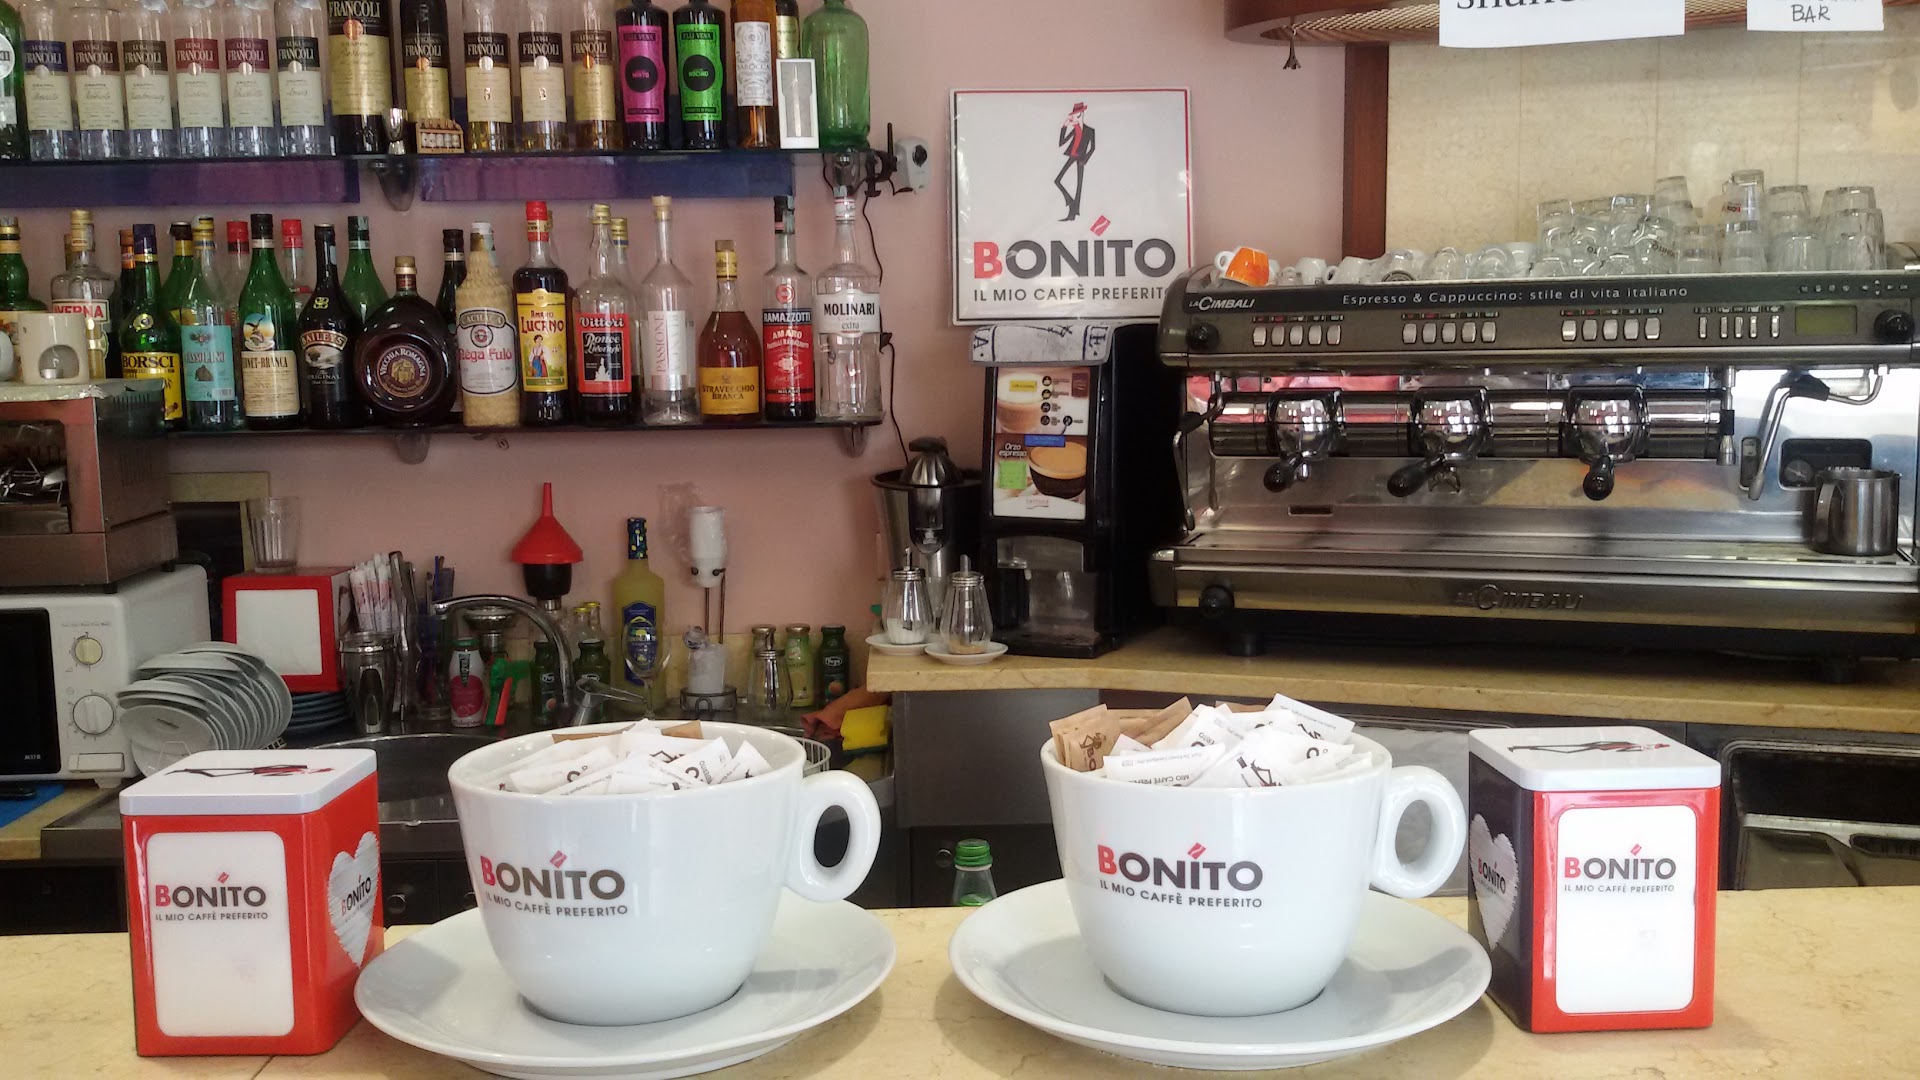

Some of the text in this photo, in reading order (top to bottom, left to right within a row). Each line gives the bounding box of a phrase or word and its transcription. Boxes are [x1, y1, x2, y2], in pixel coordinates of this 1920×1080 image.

[328, 0, 381, 18] FRANCOLI
[1791, 3, 1831, 22] BAR
[278, 48, 314, 60] FRANCOLI
[405, 44, 442, 57] FRANCOLI
[467, 43, 505, 56] FRANCOLI
[522, 43, 559, 55] FRANCOLI
[573, 42, 607, 54] FRANCOLI
[24, 51, 62, 64] FRANCOLI
[75, 51, 114, 64] FRANCOLI
[125, 51, 162, 64] FRANCOLI
[177, 49, 214, 62] FRANCOLI
[228, 50, 264, 62] FRANCOLI
[973, 232, 1176, 279] BONITO
[973, 290, 987, 302] IL
[993, 288, 1027, 301] MIO
[1033, 284, 1085, 301] CAFFÈ
[1342, 286, 1688, 306] Espresso & Cappuccino: stile di vita italiano
[823, 302, 875, 316] MOLINARI
[1188, 295, 1255, 311] LA CIMBALI
[531, 310, 554, 319] AMARO
[763, 311, 811, 322] RAMAZZOTTI
[521, 317, 565, 333] LUCANO
[579, 317, 624, 328] Vittori
[841, 322, 860, 330] extra
[301, 331, 343, 346] BAILEYS
[772, 329, 803, 340] AMARO
[653, 314, 666, 373] PASSIONE
[122, 355, 175, 368] BORSCI
[379, 347, 427, 377] VECCHIA ROMAGNA
[712, 392, 745, 400] BRANCA
[998, 448, 1027, 458] espresso
[1004, 443, 1022, 451] Orzo
[1097, 844, 1264, 892] BONITO
[1564, 857, 1677, 880] BONITO
[480, 855, 626, 900] BONITO
[1478, 858, 1506, 895] BONITO
[1100, 880, 1263, 909] IL MIO CAFFÈ PREFERITO
[1575, 884, 1594, 892] MIO
[1597, 883, 1627, 893] CAFFÈ
[1630, 884, 1675, 893] PREFERITO
[155, 885, 267, 907] BONITO
[341, 876, 372, 917] BONITO
[493, 896, 512, 908] MIO
[515, 901, 552, 916] CAFFÈ
[556, 905, 629, 917] PREFERITO
[155, 911, 269, 921] IL MIO CAFFÈ PREFERITO
